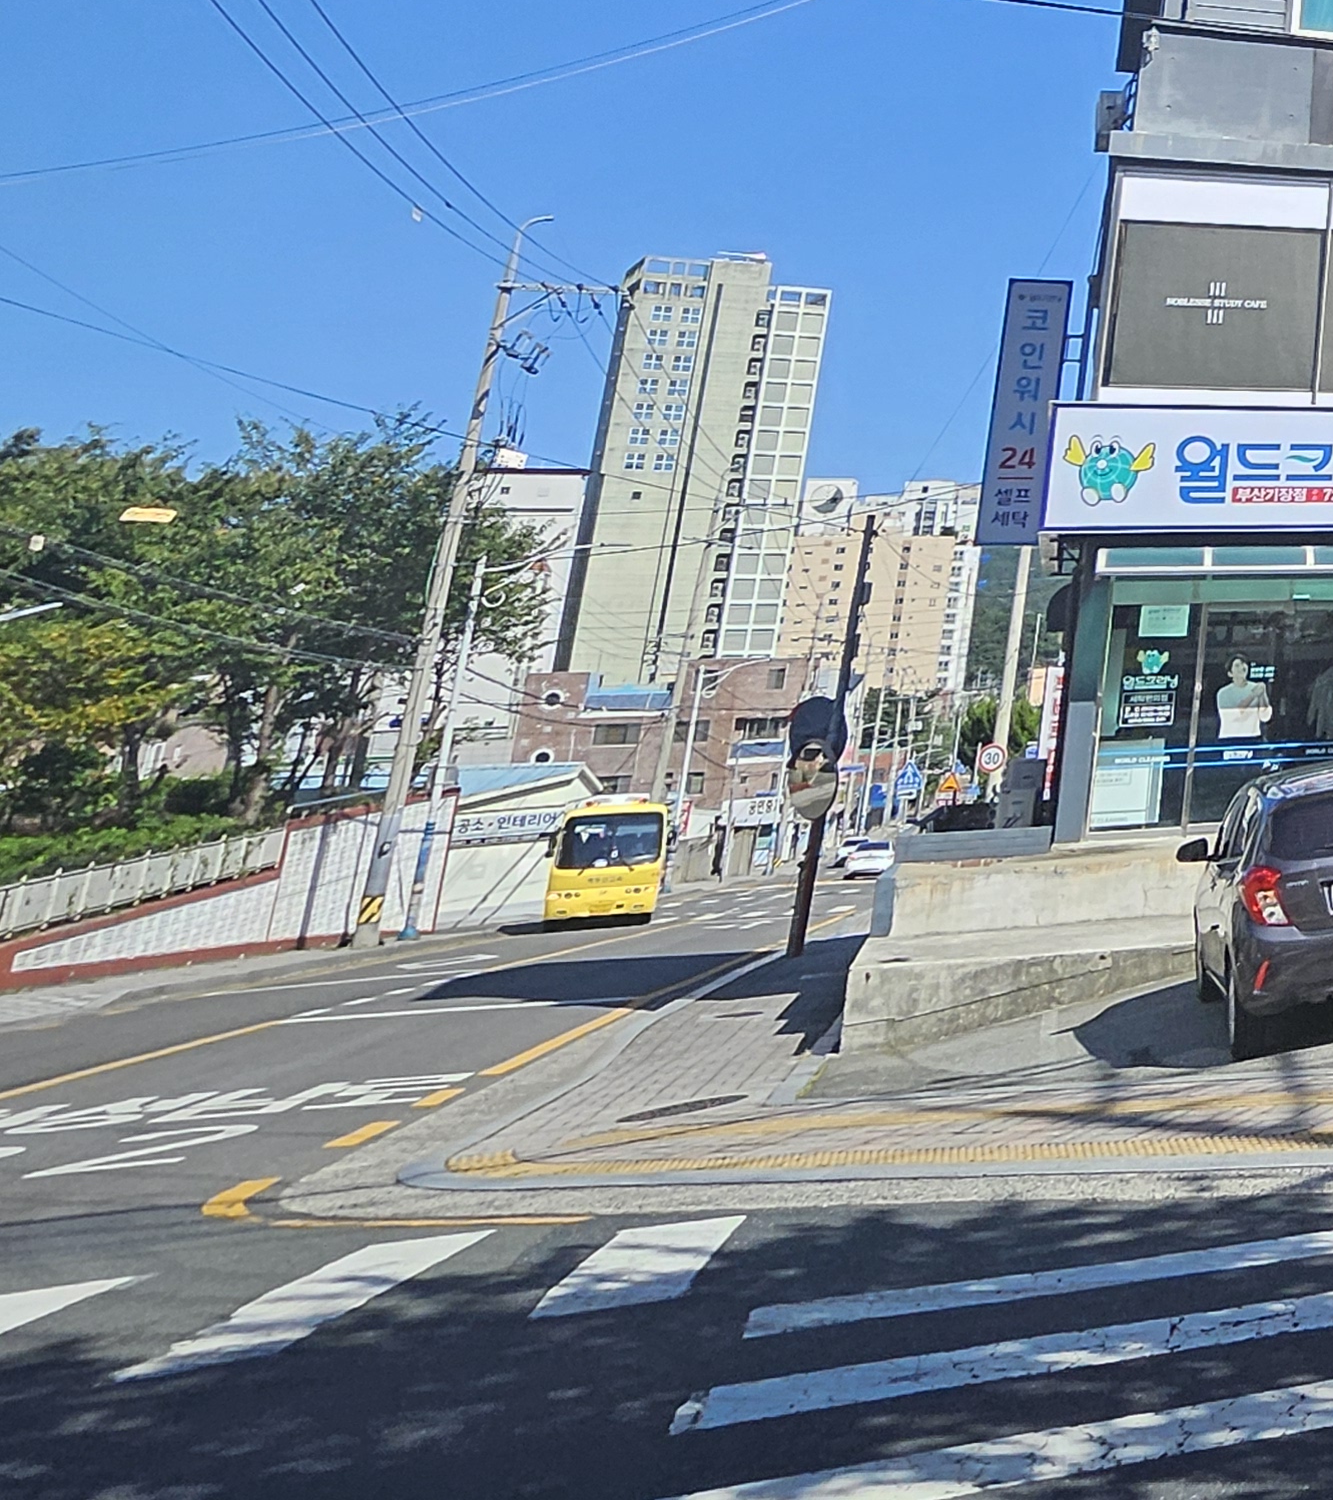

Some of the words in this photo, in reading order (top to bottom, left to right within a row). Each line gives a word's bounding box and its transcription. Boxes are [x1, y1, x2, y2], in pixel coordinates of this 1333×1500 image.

[998, 446, 1036, 471] 24
[994, 487, 1032, 505] 셀프
[1235, 488, 1307, 503] 부산기장점
[991, 510, 1029, 530] 세탁
[984, 752, 1000, 765] 30
[496, 812, 559, 830] 인테리어
